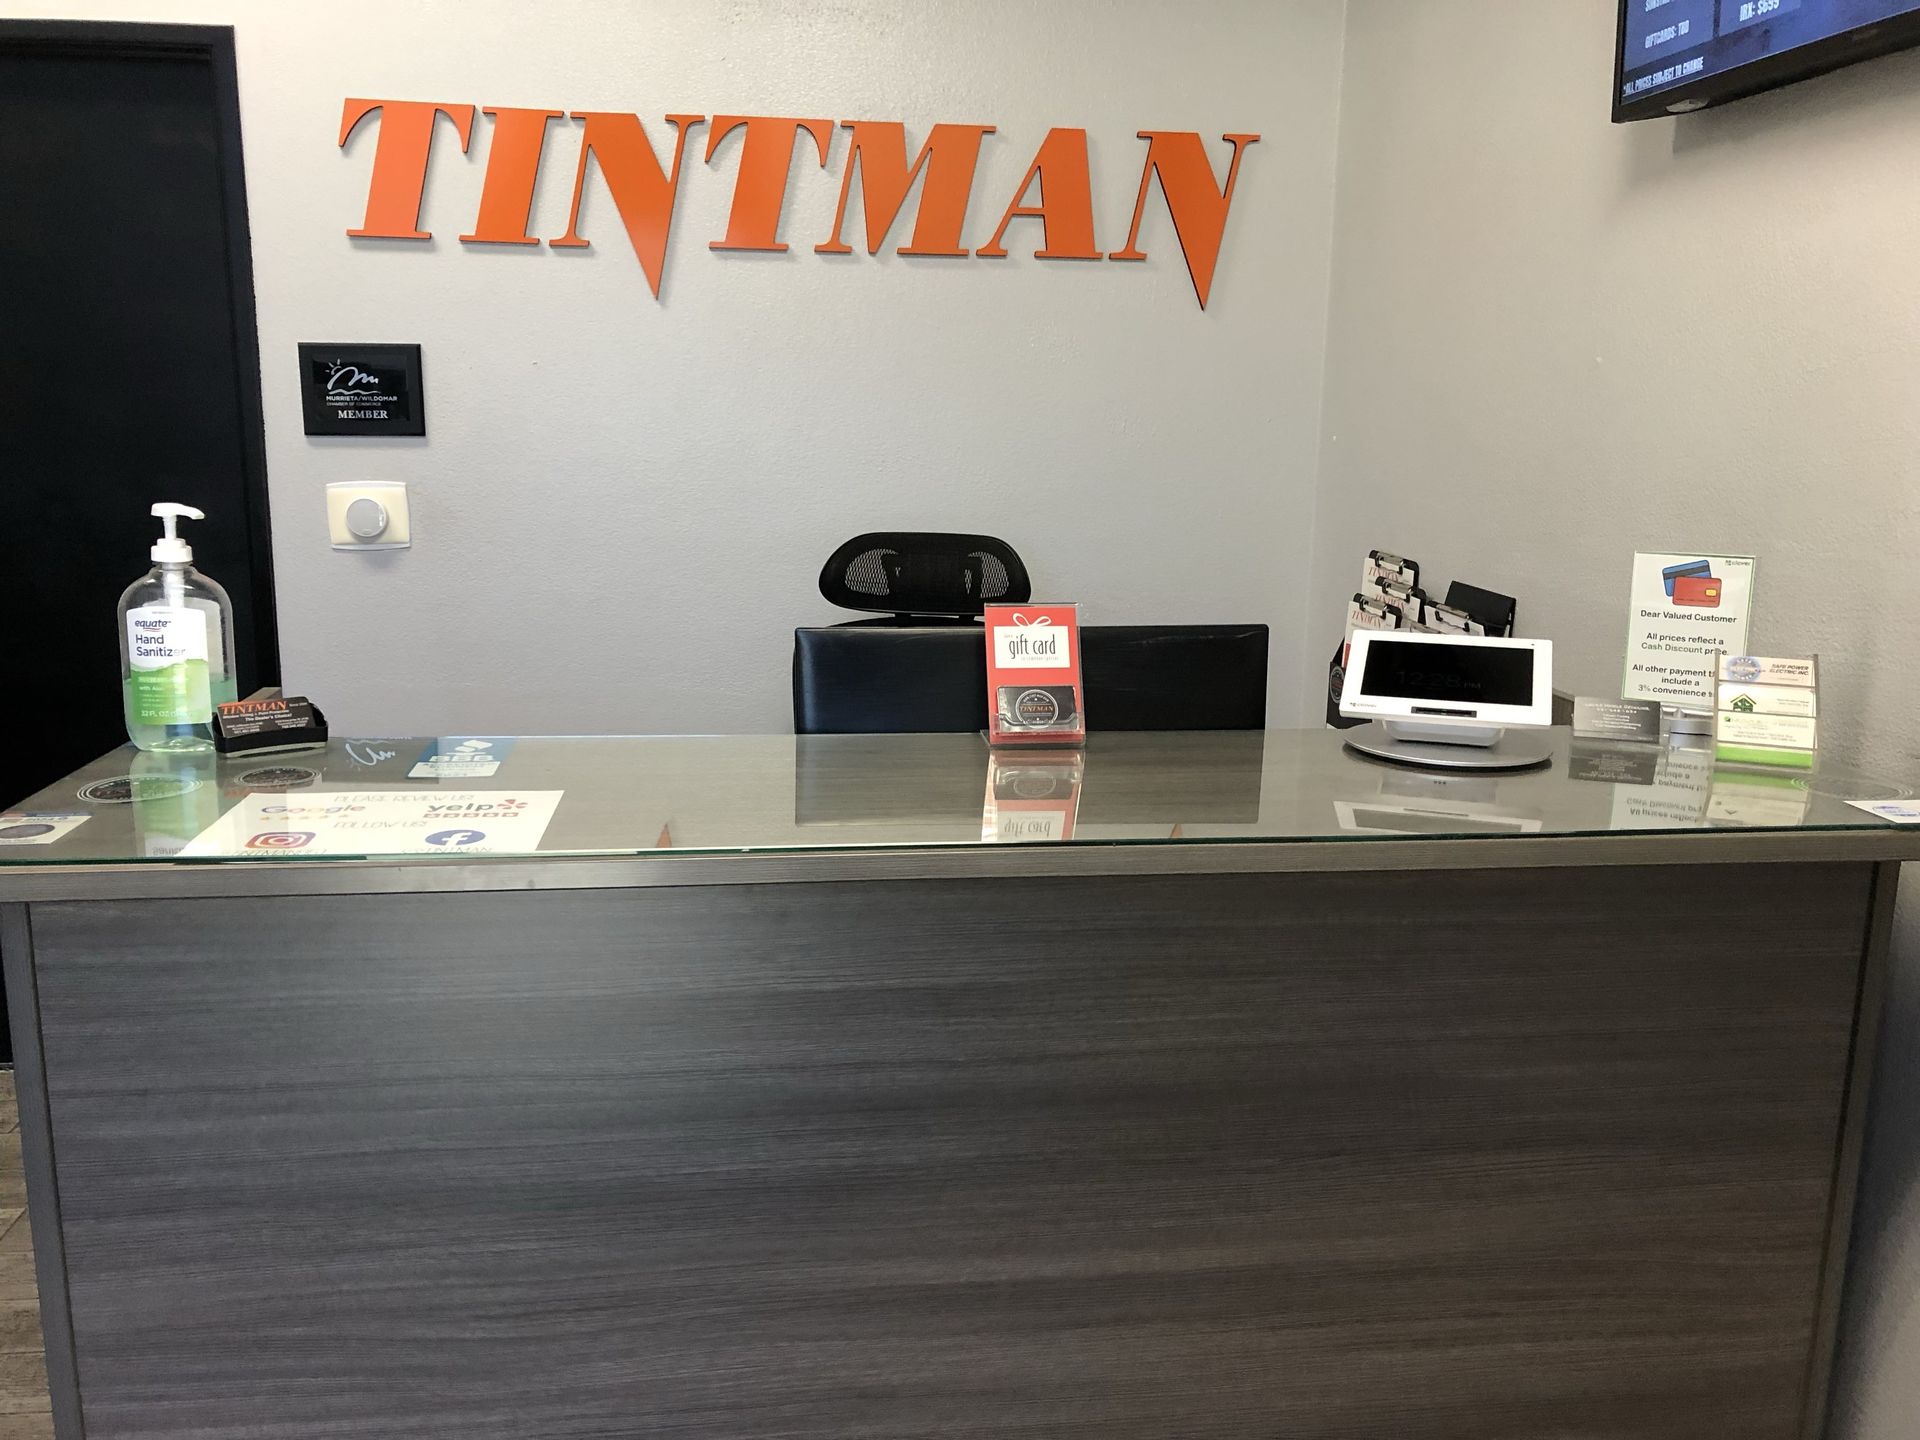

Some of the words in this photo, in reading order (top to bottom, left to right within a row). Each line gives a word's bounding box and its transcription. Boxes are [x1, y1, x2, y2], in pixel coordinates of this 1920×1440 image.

[338, 97, 1261, 311] TINTMAN
[337, 409, 389, 419] MEMBER
[1640, 609, 1661, 618] Dear
[1663, 611, 1692, 621] Valued
[1694, 613, 1738, 624] Customer
[134, 619, 168, 629] equate
[135, 634, 165, 645] Hand
[1646, 632, 1658, 641] All
[1659, 634, 1686, 643] prices
[1688, 635, 1717, 645] reflect
[1008, 633, 1029, 660] gift
[1032, 633, 1056, 655] card
[1641, 642, 1663, 650] Cash
[1664, 643, 1703, 654] Discount
[1632, 664, 1644, 672] All
[1645, 665, 1667, 674] other
[1669, 667, 1707, 678] payment
[1661, 676, 1692, 686] include
[1652, 686, 1707, 698] convenience
[223, 701, 287, 715] TINTMAN
[261, 804, 366, 814] Google
[427, 802, 495, 813] yelp
